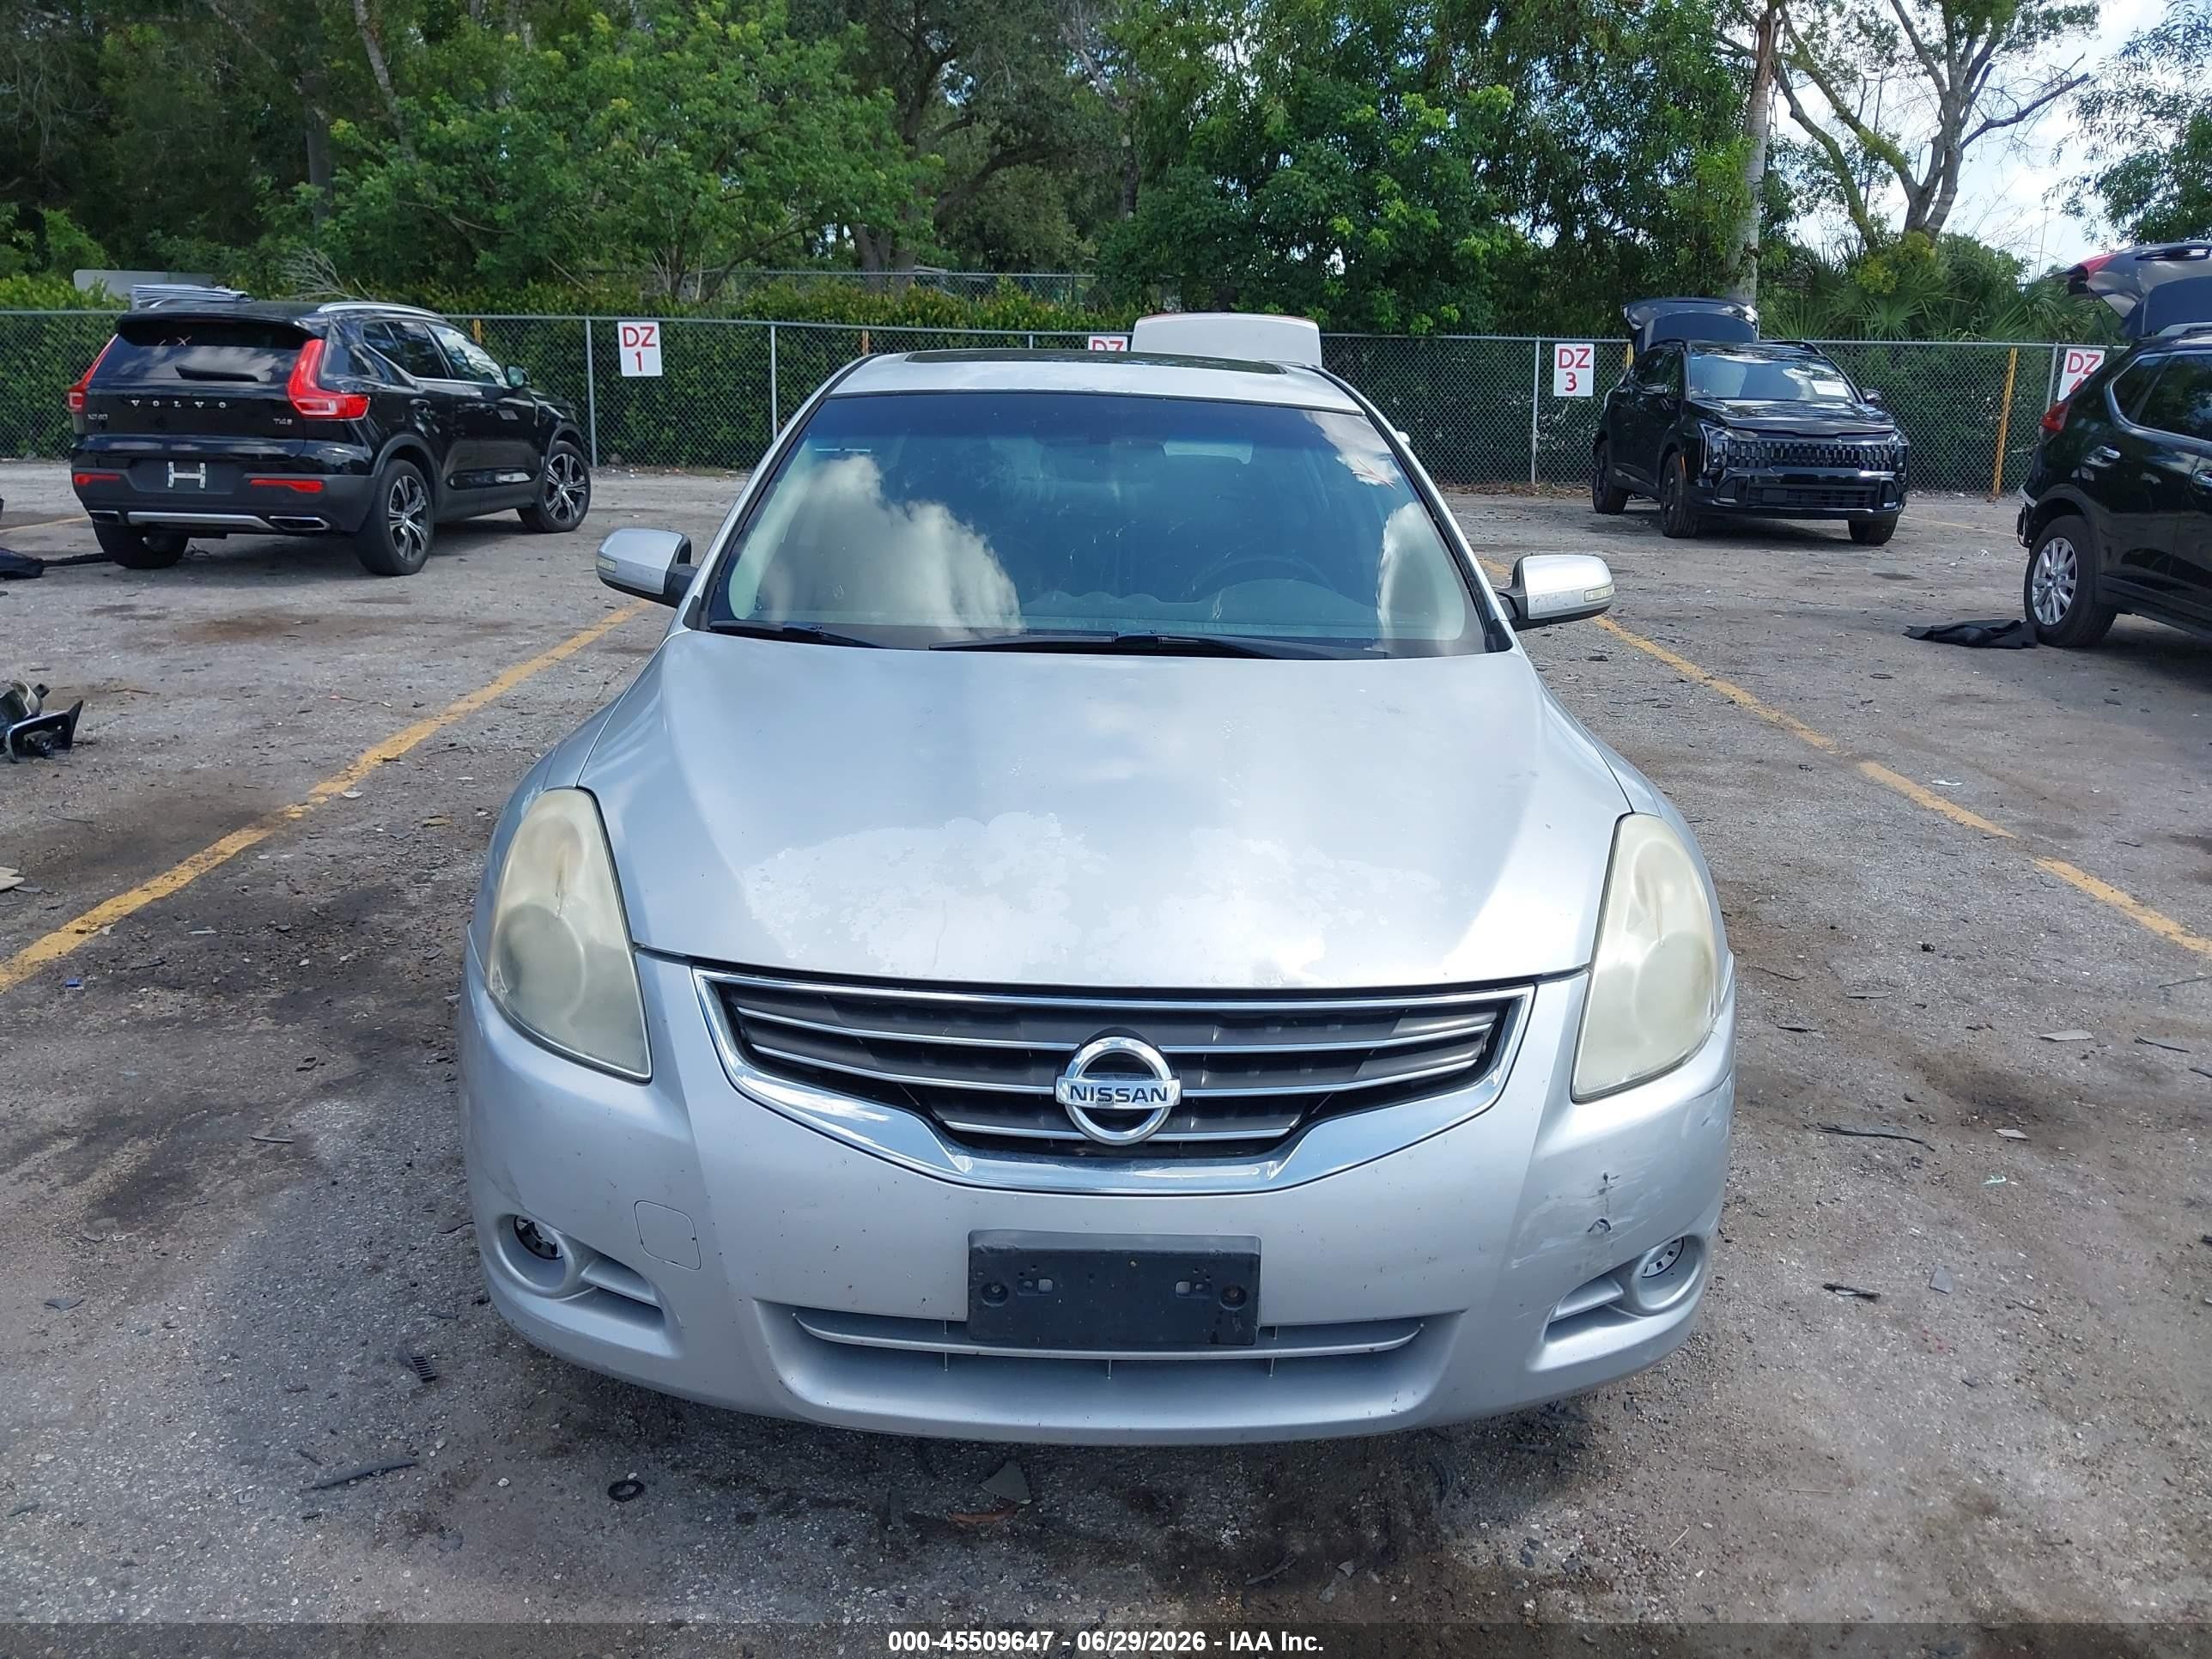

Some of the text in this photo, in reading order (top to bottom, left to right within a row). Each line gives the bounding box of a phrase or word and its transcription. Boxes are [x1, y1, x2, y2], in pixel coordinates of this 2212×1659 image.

[623, 326, 657, 348] DZ
[635, 350, 642, 372] 1
[1558, 348, 1590, 369] DZ
[2067, 352, 2100, 374] DZ
[1565, 372, 1577, 392] 3
[131, 399, 227, 409] VOLVO
[1070, 1085, 1168, 1103] NISSAN
